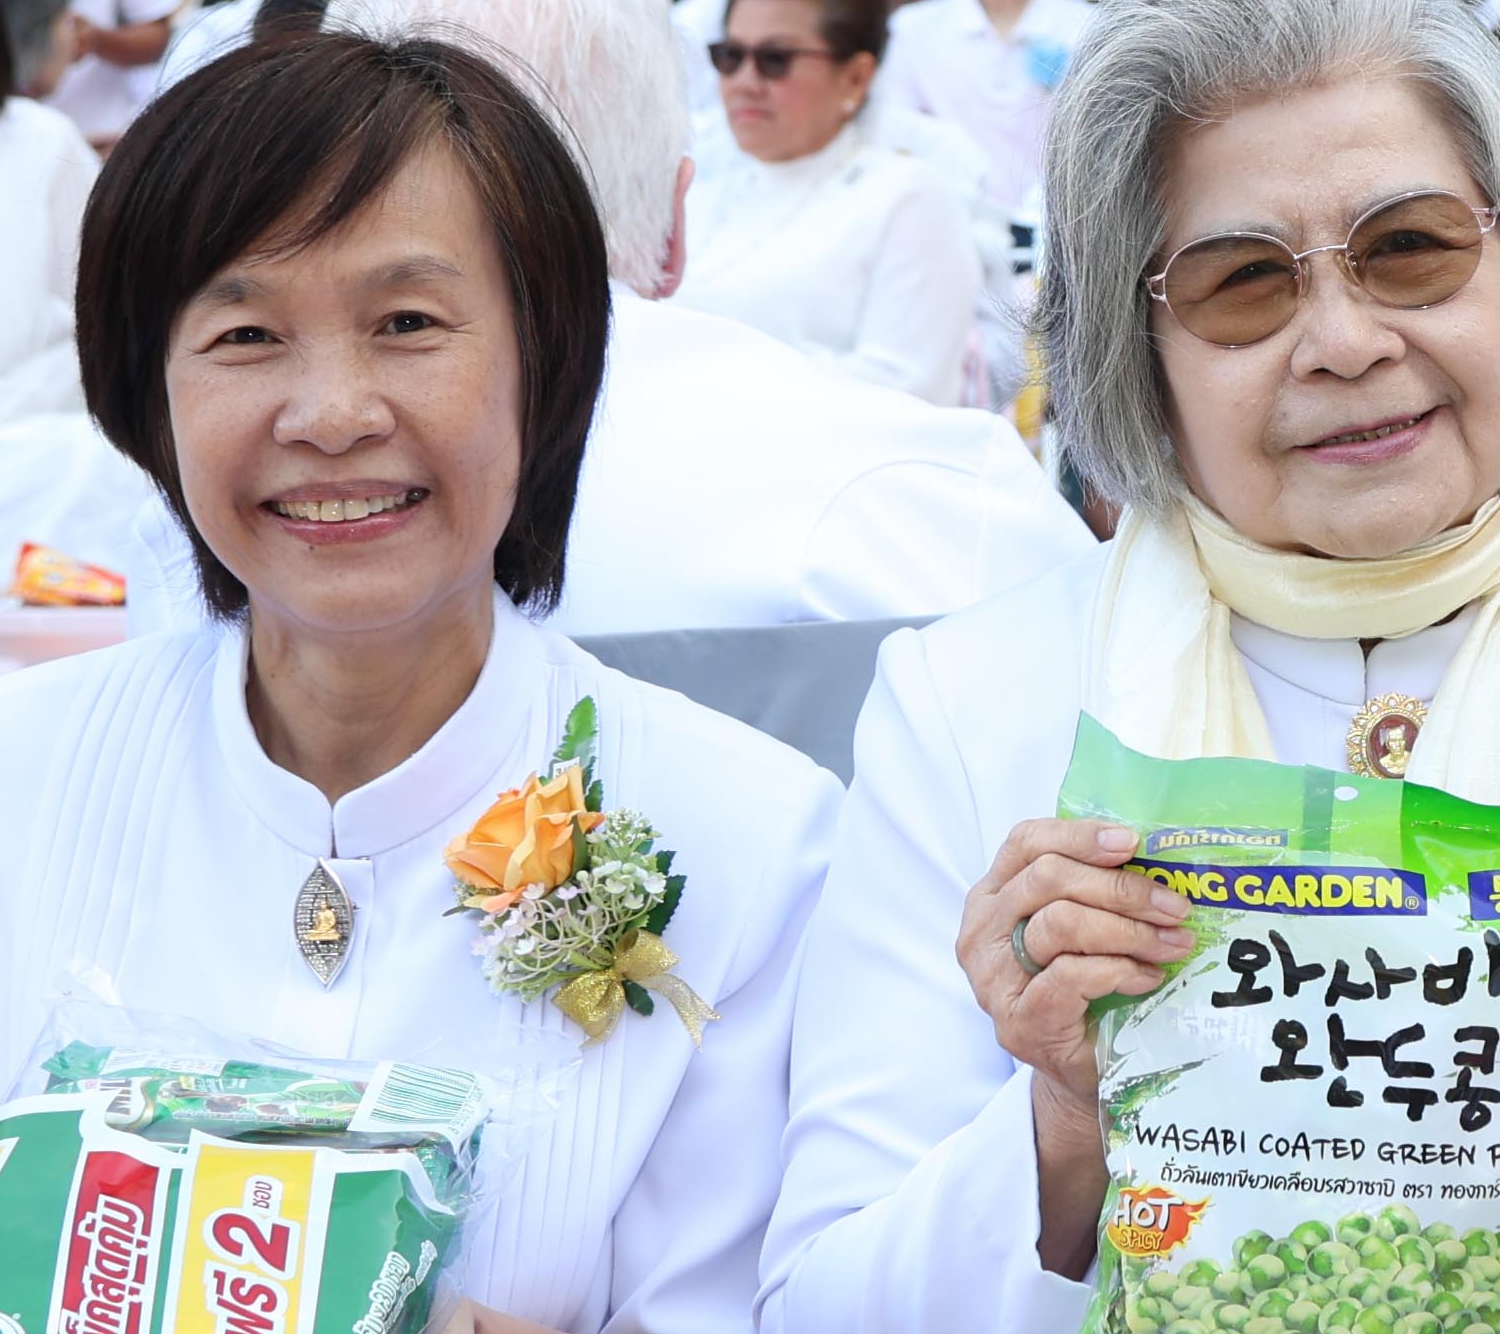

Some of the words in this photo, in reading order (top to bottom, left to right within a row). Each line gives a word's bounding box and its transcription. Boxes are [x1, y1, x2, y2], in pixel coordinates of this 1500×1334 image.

[1236, 873, 1403, 909] GARDEN
[1137, 1124, 1246, 1155] WASABI
[1259, 1132, 1366, 1161] COATED
[1378, 1138, 1476, 1167] GREEN
[1160, 1161, 1396, 1197] ถั่วลันเตาเขียวเคลือบรสวาซาบิ
[1403, 1182, 1434, 1199] ตรา
[212, 1213, 290, 1272] 2
[252, 1180, 272, 1209] ซอง
[1112, 1196, 1184, 1231] HOT
[1119, 1229, 1164, 1250] SPICY
